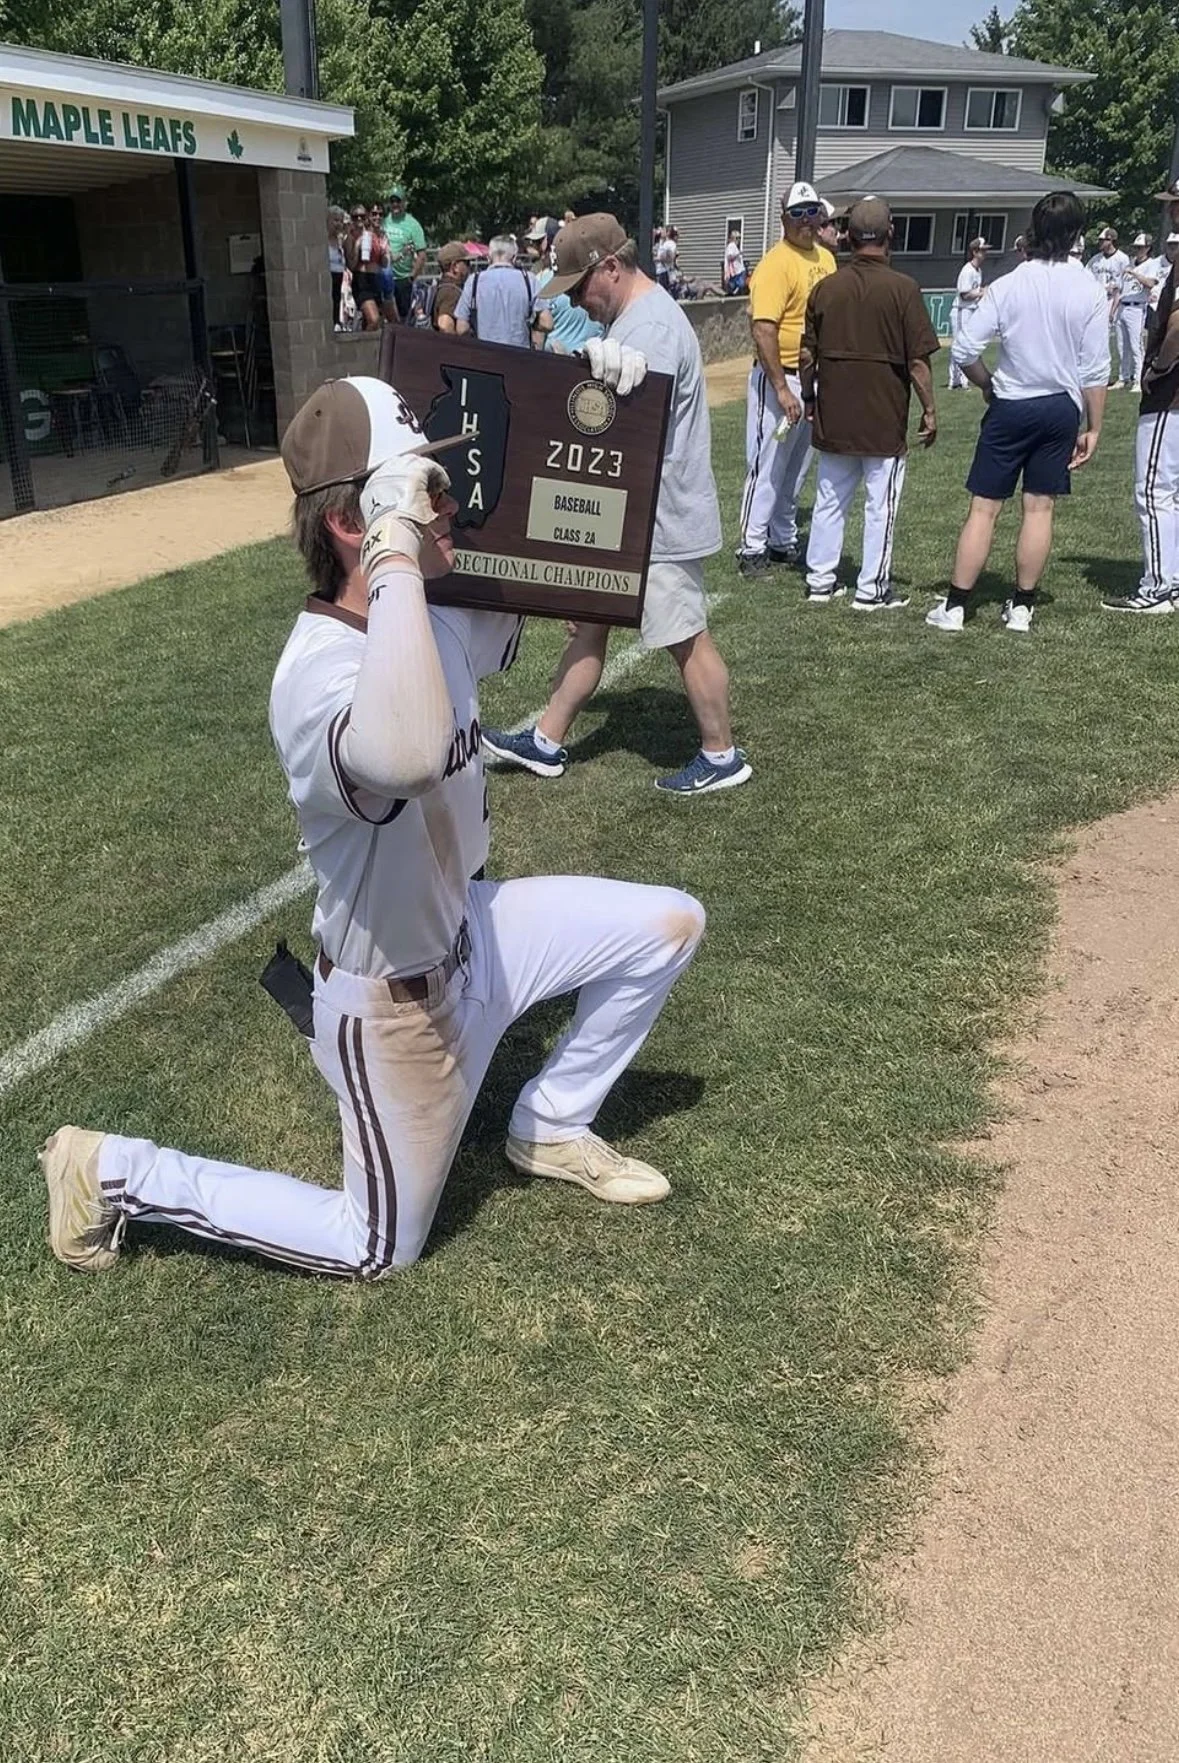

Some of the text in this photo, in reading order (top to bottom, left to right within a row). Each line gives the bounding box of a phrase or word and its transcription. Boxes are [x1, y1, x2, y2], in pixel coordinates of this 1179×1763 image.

[12, 97, 197, 156] MAPLE LEAFS
[546, 440, 623, 478] 2023
[553, 494, 601, 516] BASEBALL
[553, 526, 596, 545] CLASS 2A
[454, 552, 630, 593] SECTIONAL CHAMPIONS
